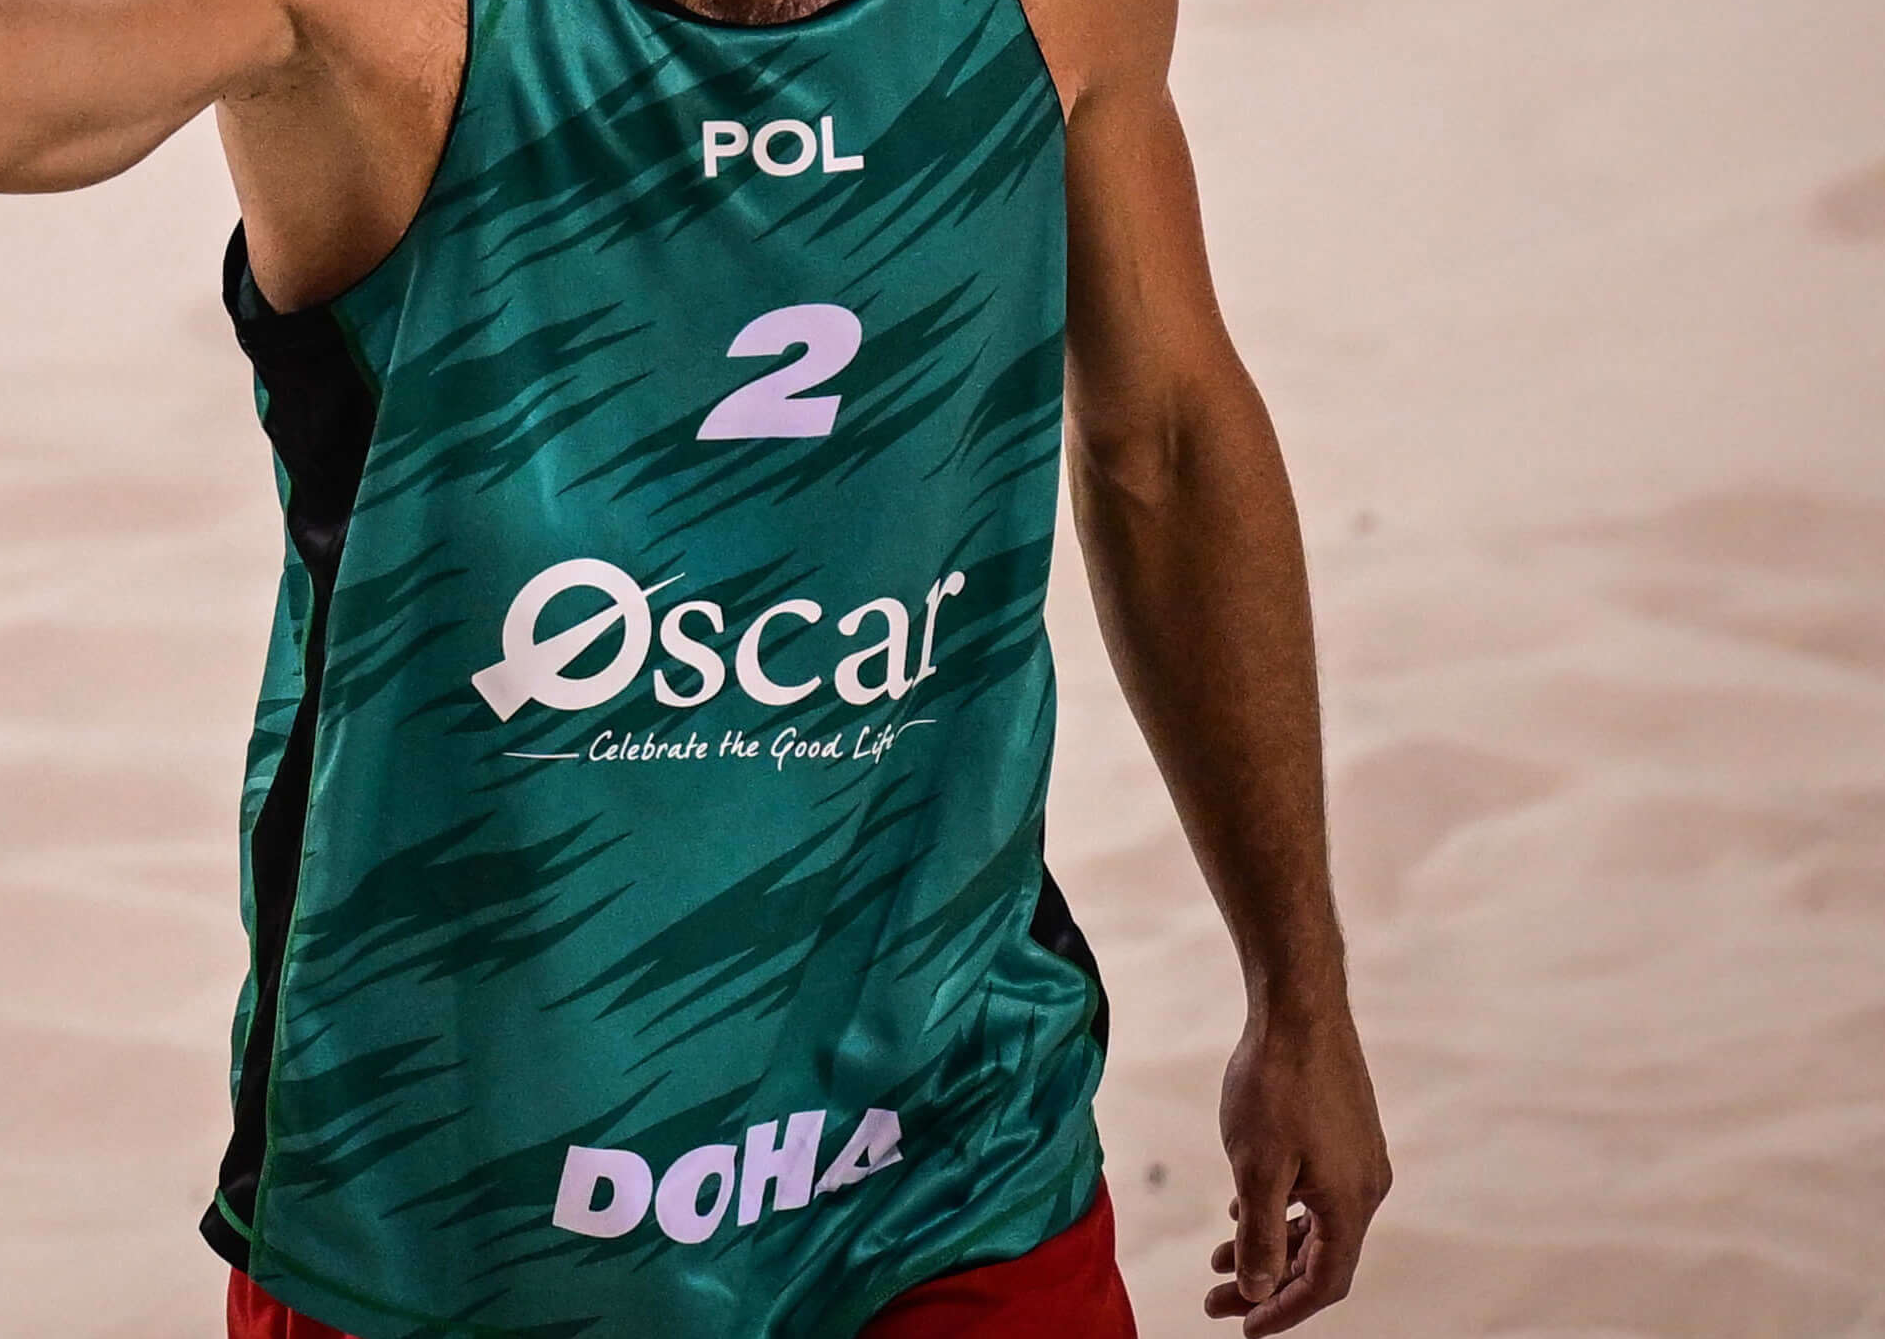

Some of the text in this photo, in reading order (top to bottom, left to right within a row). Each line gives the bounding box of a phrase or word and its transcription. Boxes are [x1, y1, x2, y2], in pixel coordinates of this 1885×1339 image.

[701, 115, 865, 178] POL
[695, 302, 863, 442] 2
[588, 729, 709, 762] Celebrate
[718, 729, 761, 759] the
[770, 726, 845, 772] Good
[552, 1107, 904, 1244] DOHA
